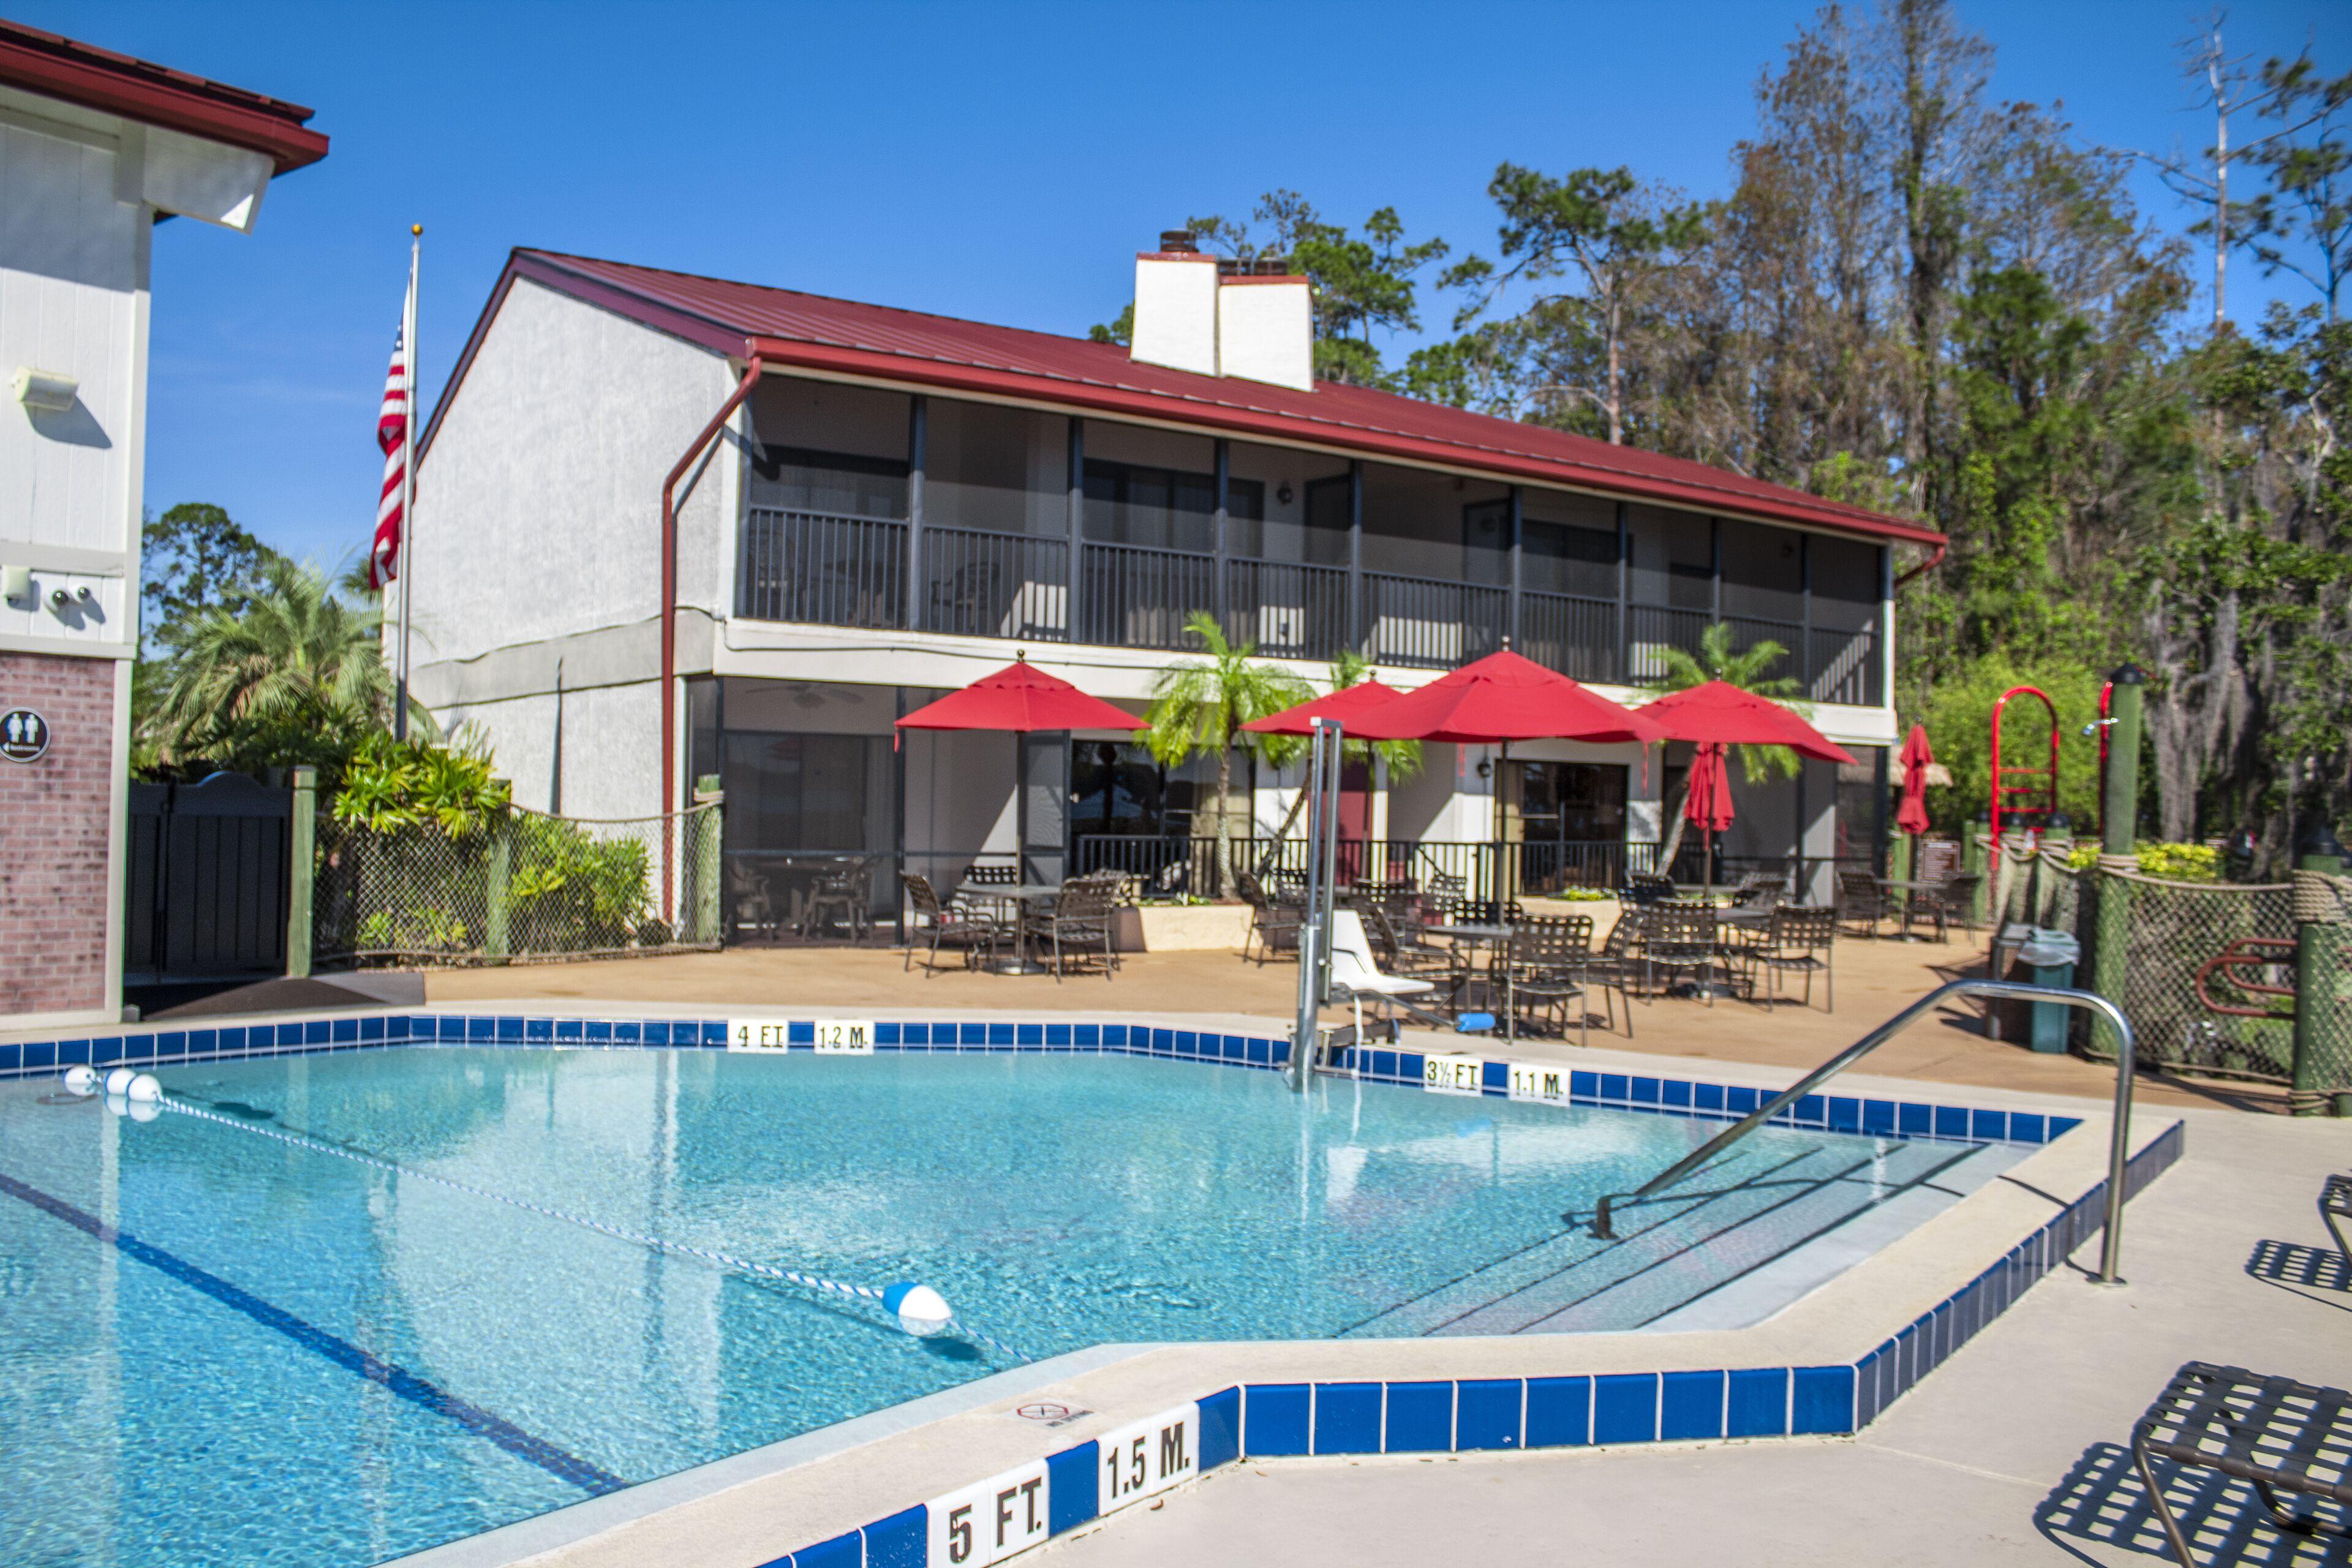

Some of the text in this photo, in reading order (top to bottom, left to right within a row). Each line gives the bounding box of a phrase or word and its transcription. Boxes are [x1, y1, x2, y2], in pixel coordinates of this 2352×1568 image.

[738, 1025, 748, 1046] 4
[820, 1027, 841, 1048] 1.2
[1513, 1071, 1534, 1093] 1.1
[1107, 1421, 1190, 1498] 1.5 M.
[949, 1476, 1042, 1564] 5 FT.
